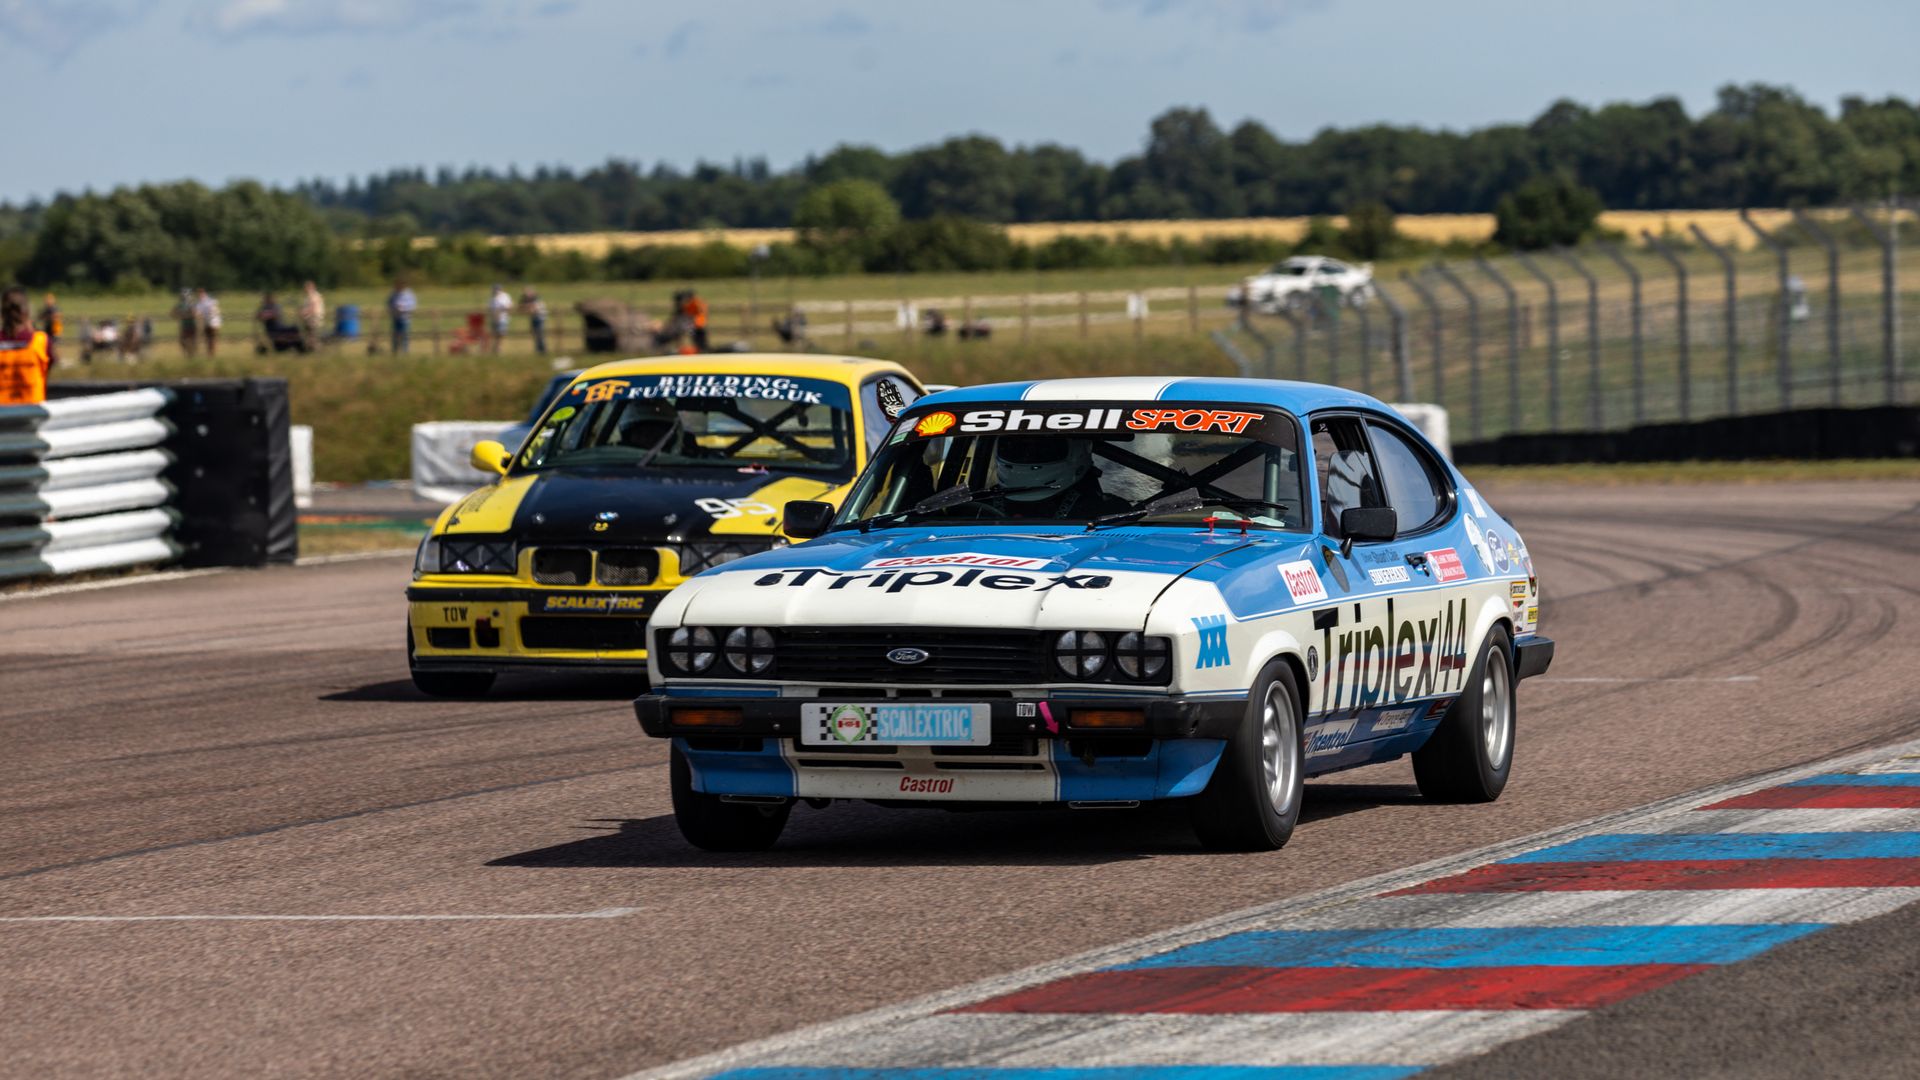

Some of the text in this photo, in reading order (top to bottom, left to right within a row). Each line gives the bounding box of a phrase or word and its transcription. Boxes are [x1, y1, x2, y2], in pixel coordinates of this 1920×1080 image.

[658, 376, 799, 390] BUILDING-
[627, 385, 822, 404] FUTURES.CO.UK
[960, 408, 1264, 434] Shell SPORT
[694, 497, 776, 519] 95
[876, 555, 1038, 568] Castrol
[781, 569, 1097, 593] Triplex
[1285, 566, 1322, 598] Castrol
[546, 596, 644, 611] SCALEXTRIC
[443, 607, 468, 622] TOW
[1018, 704, 1035, 716] TOW
[880, 708, 970, 738] SCALEXTRIC
[899, 776, 954, 793] Castrol
